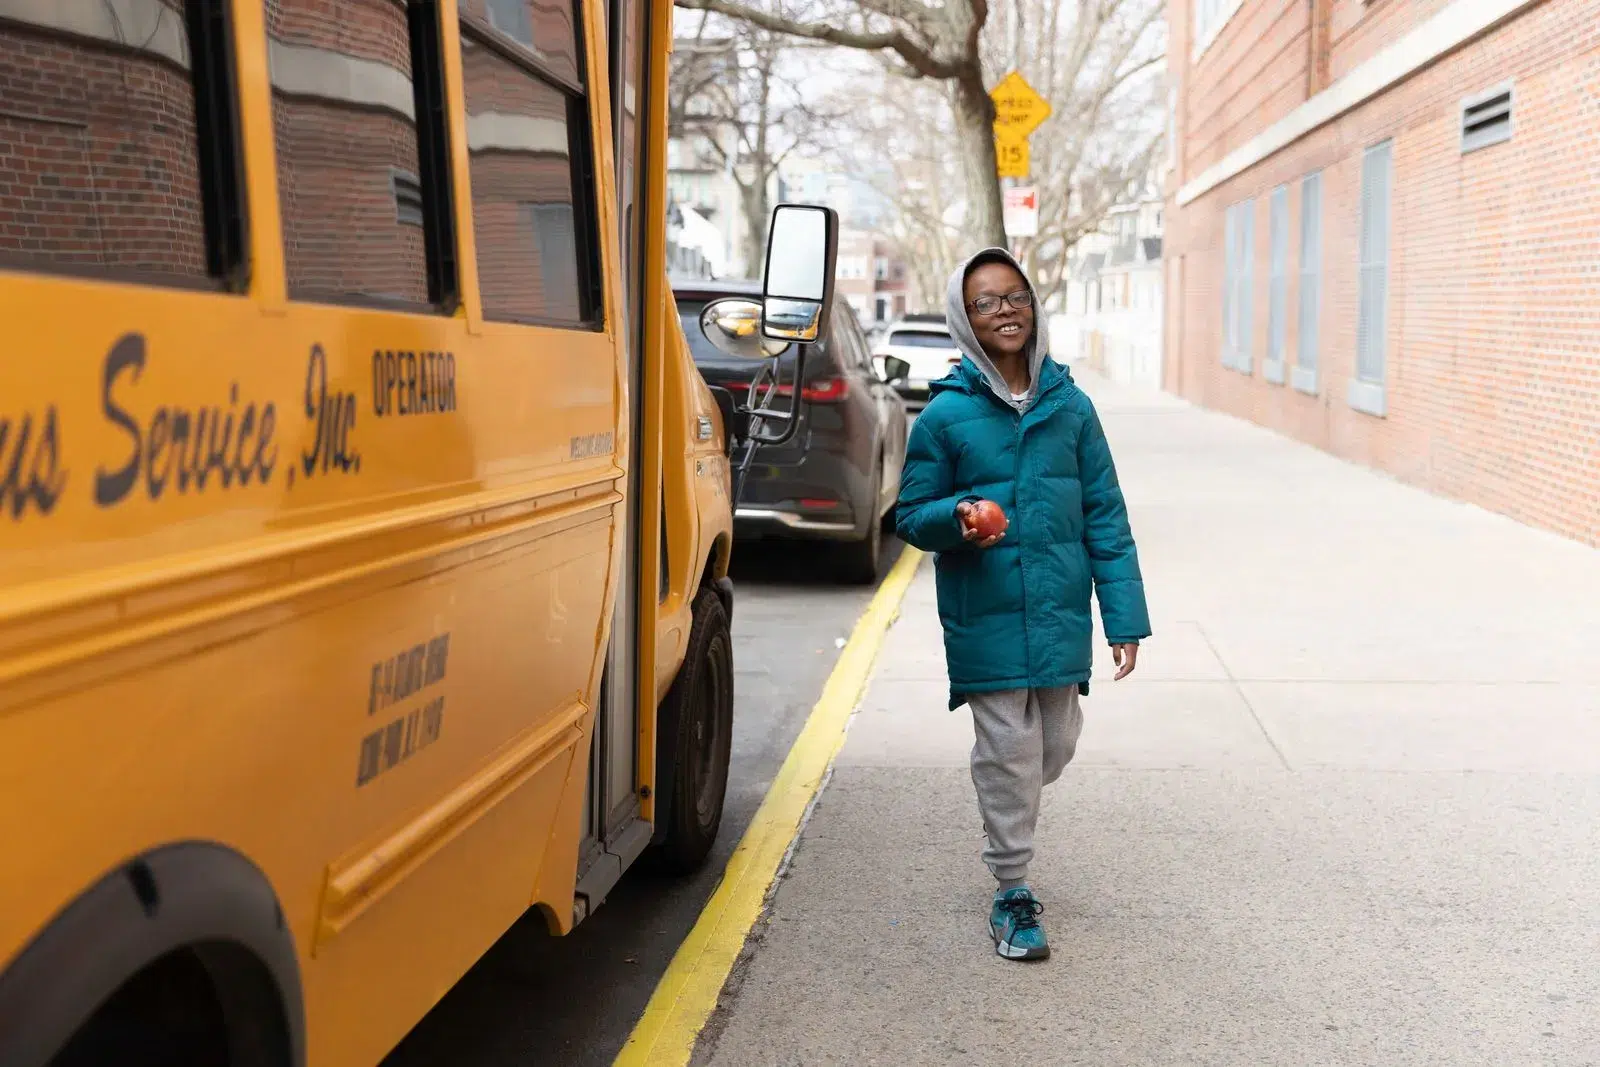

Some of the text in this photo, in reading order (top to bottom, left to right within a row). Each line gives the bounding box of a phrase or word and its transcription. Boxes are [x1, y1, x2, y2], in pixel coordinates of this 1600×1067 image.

[1001, 146, 1022, 164] 15
[302, 341, 360, 478] Inc.
[373, 348, 456, 417] OPERATOR
